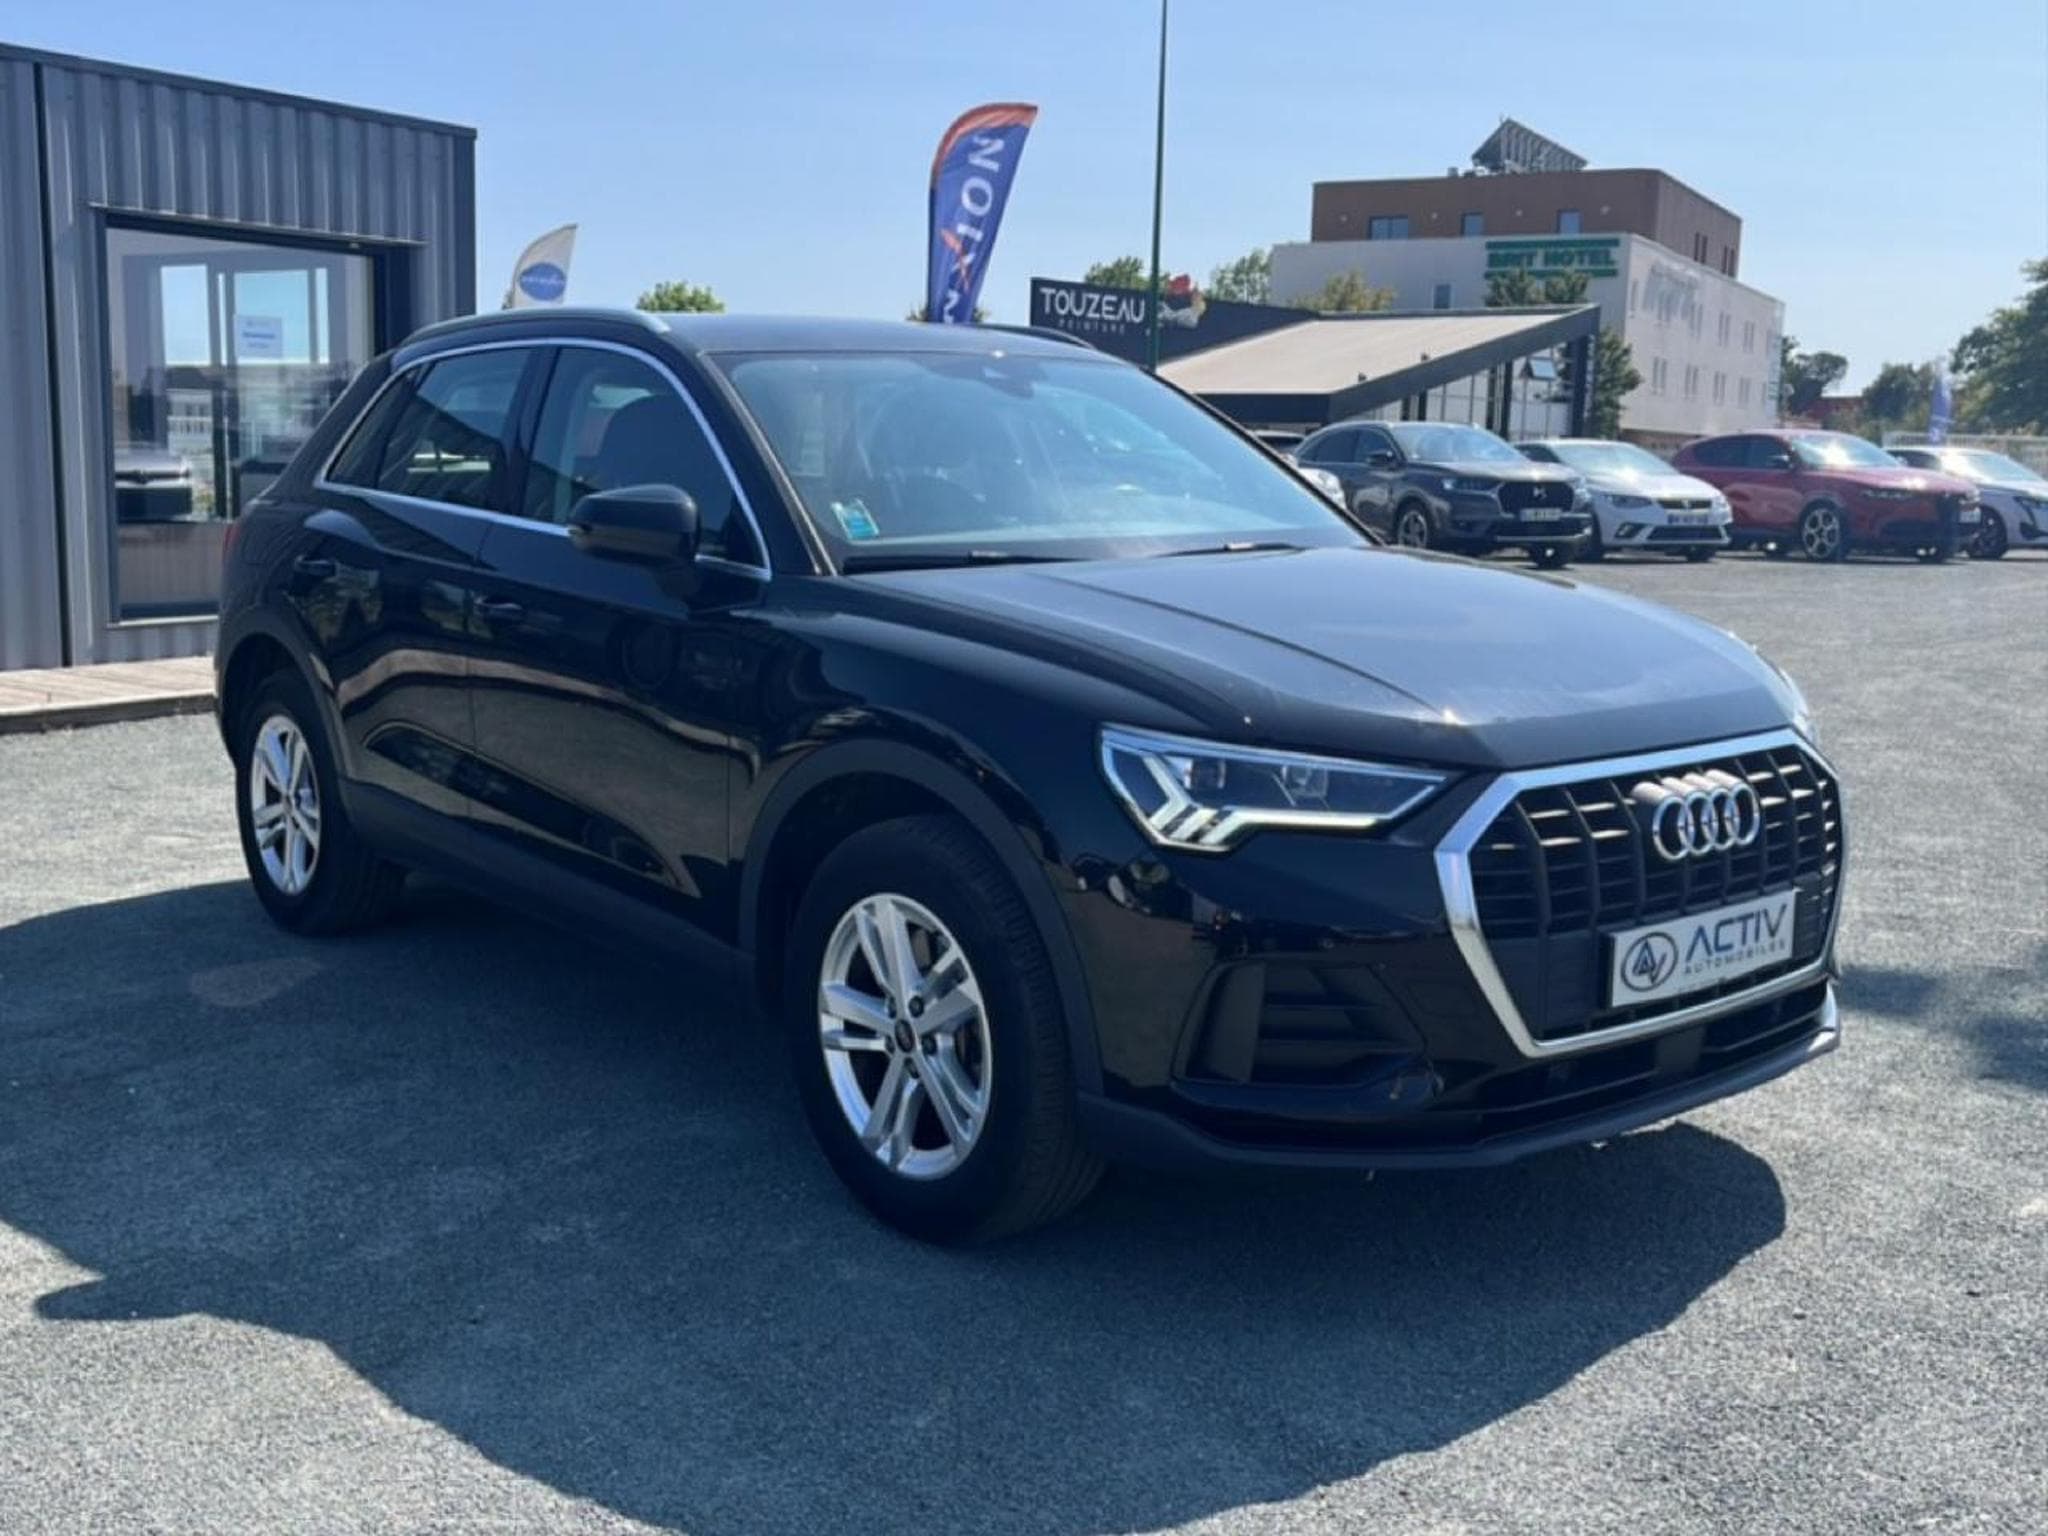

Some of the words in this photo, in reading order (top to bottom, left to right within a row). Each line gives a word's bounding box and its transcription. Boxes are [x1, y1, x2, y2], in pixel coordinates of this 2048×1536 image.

[1543, 248, 1616, 267] HOTEL
[1040, 287, 1145, 323] TOUZEAU
[1686, 903, 1787, 963] ACTIV
